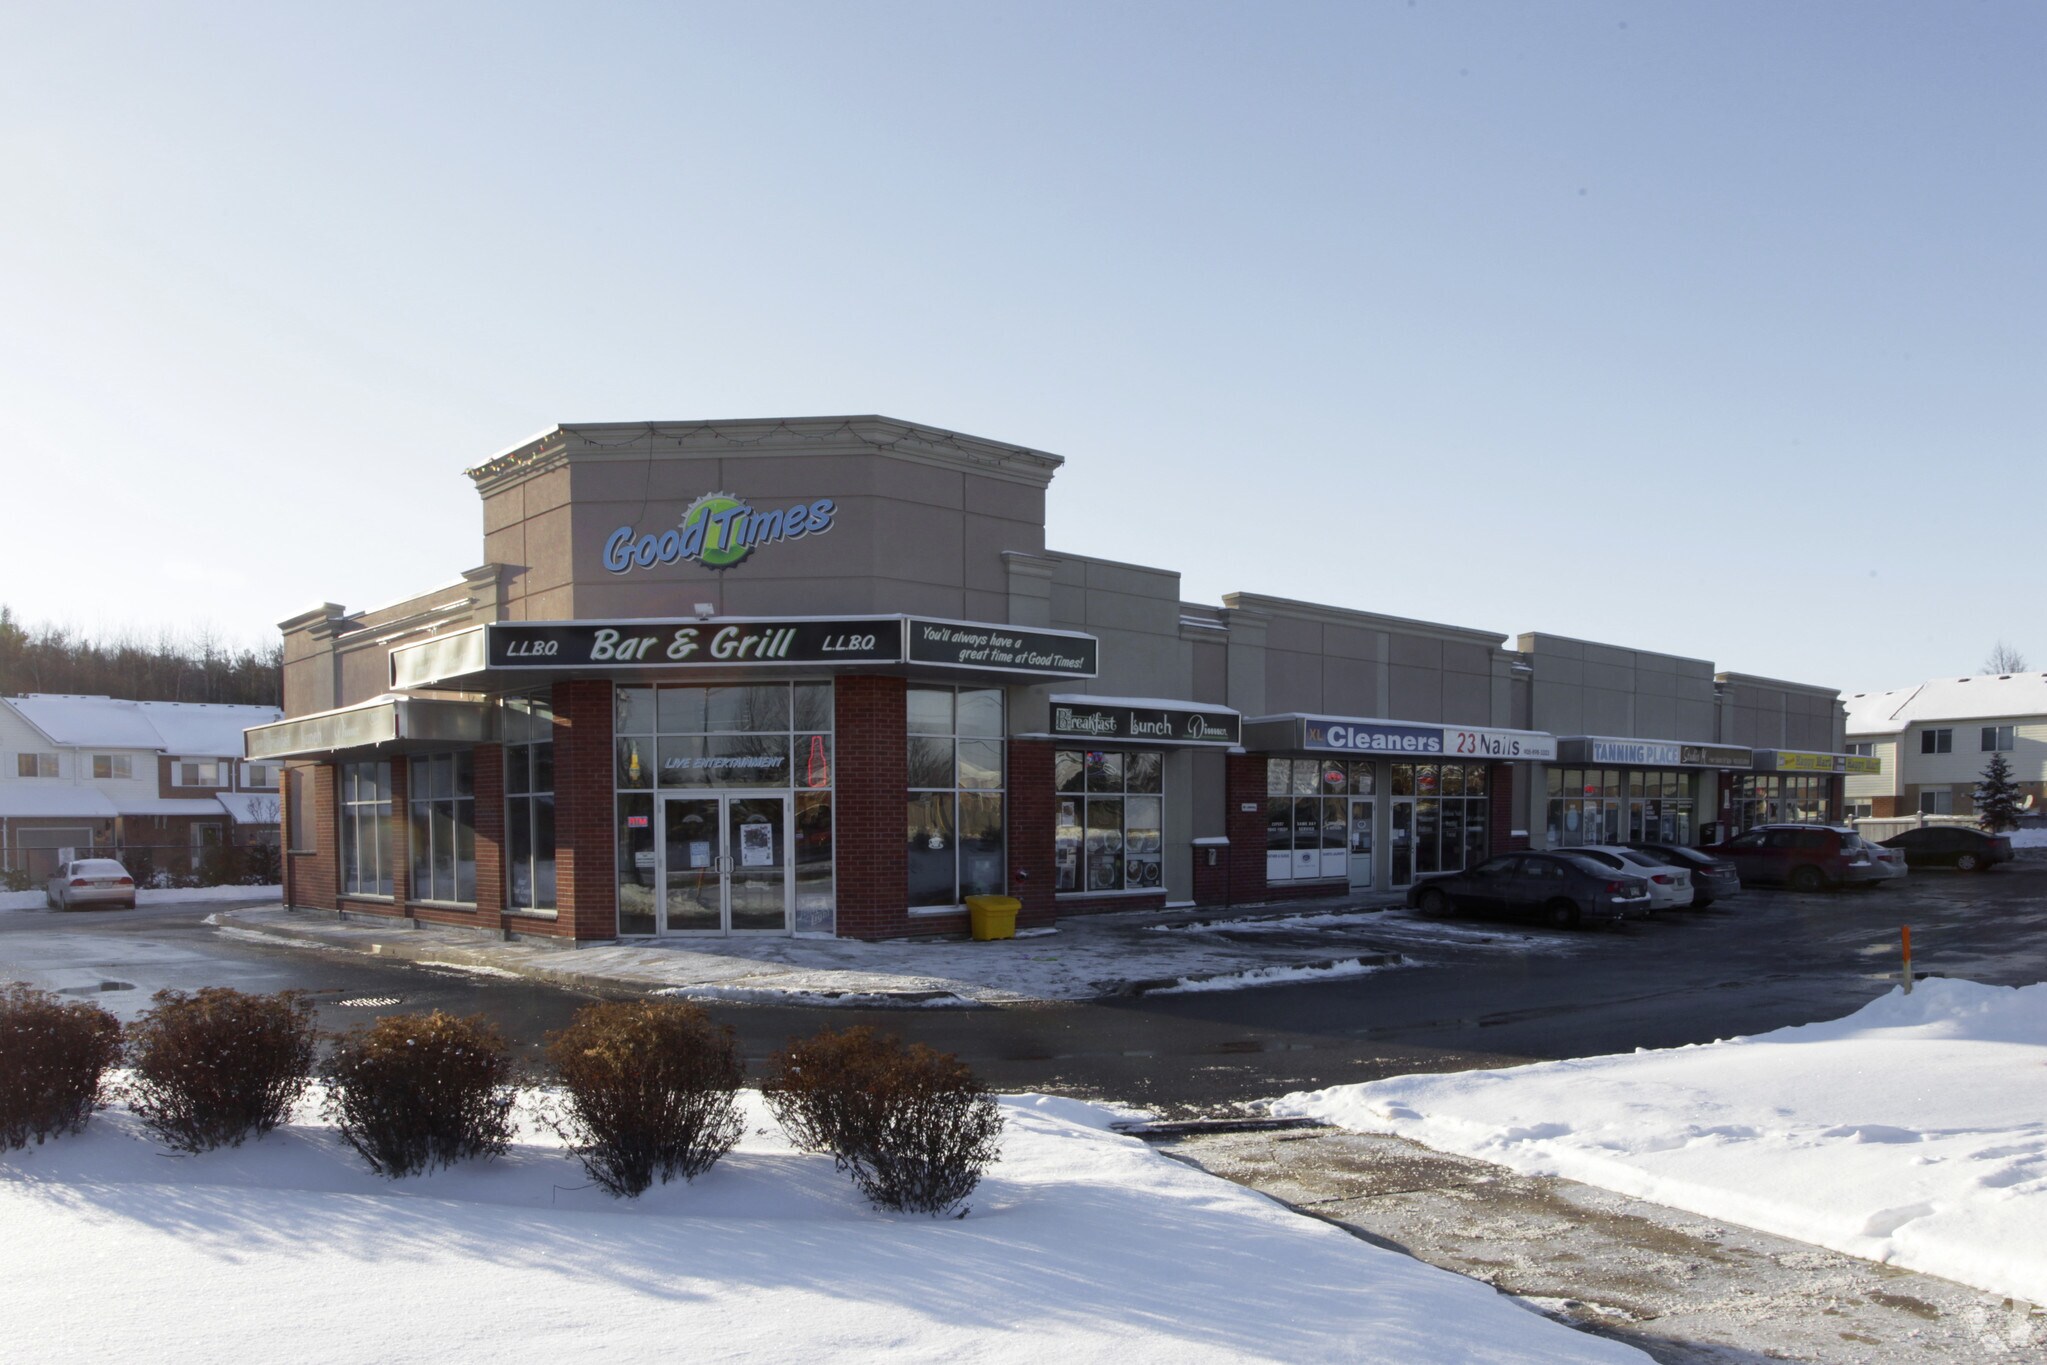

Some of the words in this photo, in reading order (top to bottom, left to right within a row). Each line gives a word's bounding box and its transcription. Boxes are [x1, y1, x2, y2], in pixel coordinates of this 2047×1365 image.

[602, 508, 711, 575] Good
[712, 499, 837, 553] Times
[590, 629, 658, 661] Bar
[666, 628, 699, 659] &
[709, 626, 796, 659] Grill
[923, 626, 951, 641] You'll
[951, 631, 987, 648] always
[989, 632, 1012, 648] have
[1014, 639, 1022, 649] a
[959, 648, 989, 662] great
[990, 650, 1013, 663] time
[1014, 651, 1029, 664] at
[1028, 652, 1053, 666] Good
[1053, 655, 1084, 669] Times!
[1056, 708, 1118, 735] Breakfast
[1130, 711, 1173, 736] Lunch
[1187, 714, 1228, 739] Dinner
[1308, 728, 1323, 742] XL
[1327, 726, 1440, 752] Cleaners
[1457, 732, 1477, 754] 23
[1480, 734, 1520, 756] Nails
[665, 757, 691, 769] LIVE
[693, 755, 785, 769] ENTERTAINMENT
[1594, 743, 1645, 763] TANNING
[1646, 744, 1678, 764] PLACE
